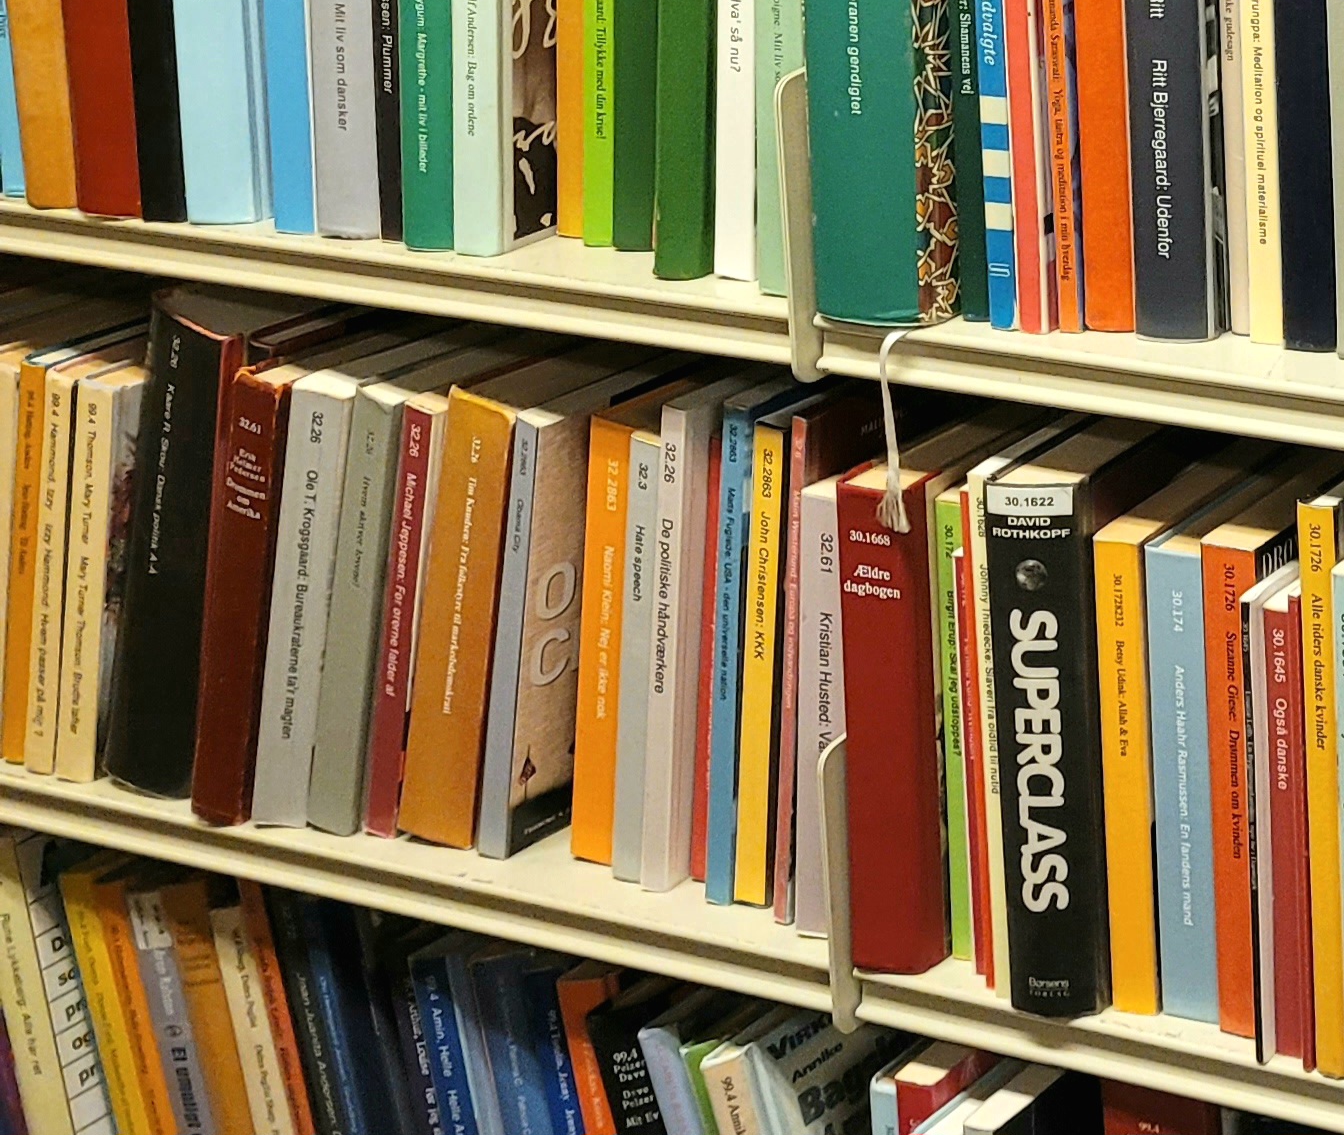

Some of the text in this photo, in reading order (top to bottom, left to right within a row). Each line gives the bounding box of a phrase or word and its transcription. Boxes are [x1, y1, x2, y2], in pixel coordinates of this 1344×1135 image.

[1151, 59, 1168, 88] Ritt
[1149, 91, 1171, 191] Bjerregaard:
[1156, 194, 1173, 259] Udenfor
[1004, 496, 1055, 507] 30.1622
[1007, 516, 1051, 527] DAVID
[850, 530, 891, 546] 30.1668
[992, 527, 1071, 539] ROTHKOPF
[653, 441, 677, 694] 32.26 De politiske håndværkere
[853, 564, 891, 581] Ældre
[843, 580, 901, 600] dagbogen
[1009, 608, 1070, 913] SUPERCLASS
